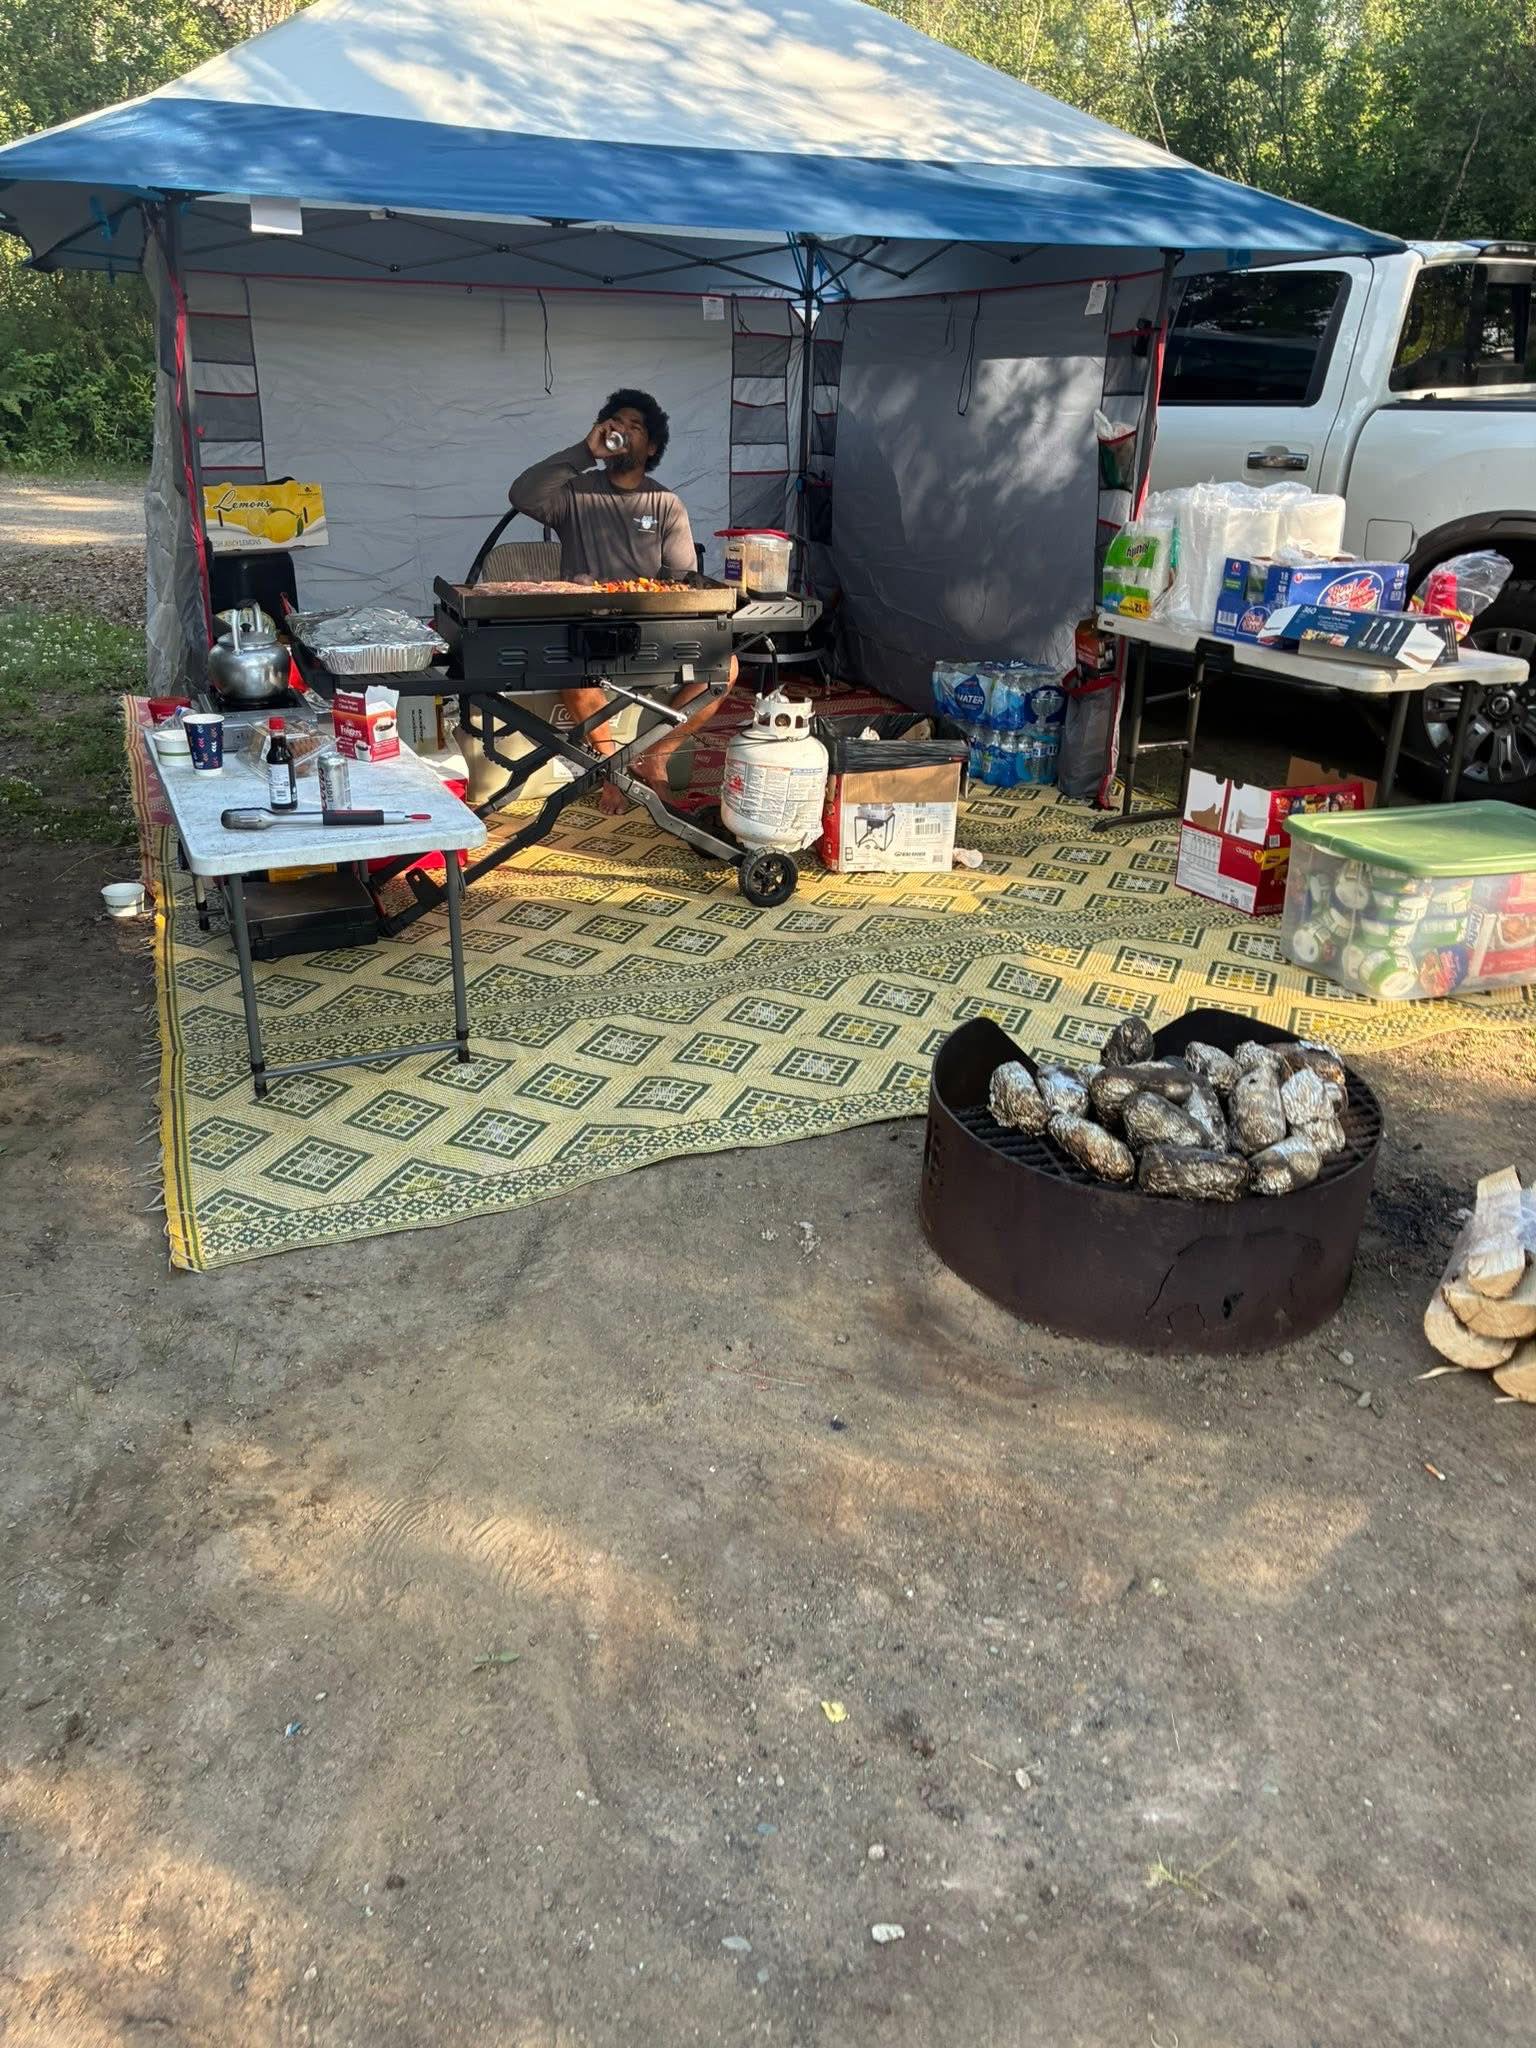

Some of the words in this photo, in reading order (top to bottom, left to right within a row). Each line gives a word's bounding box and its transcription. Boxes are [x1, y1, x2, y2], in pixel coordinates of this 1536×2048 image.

[213, 490, 271, 512] Lemons
[340, 725, 362, 738] Folgers
[324, 777, 334, 803] LIGHT
